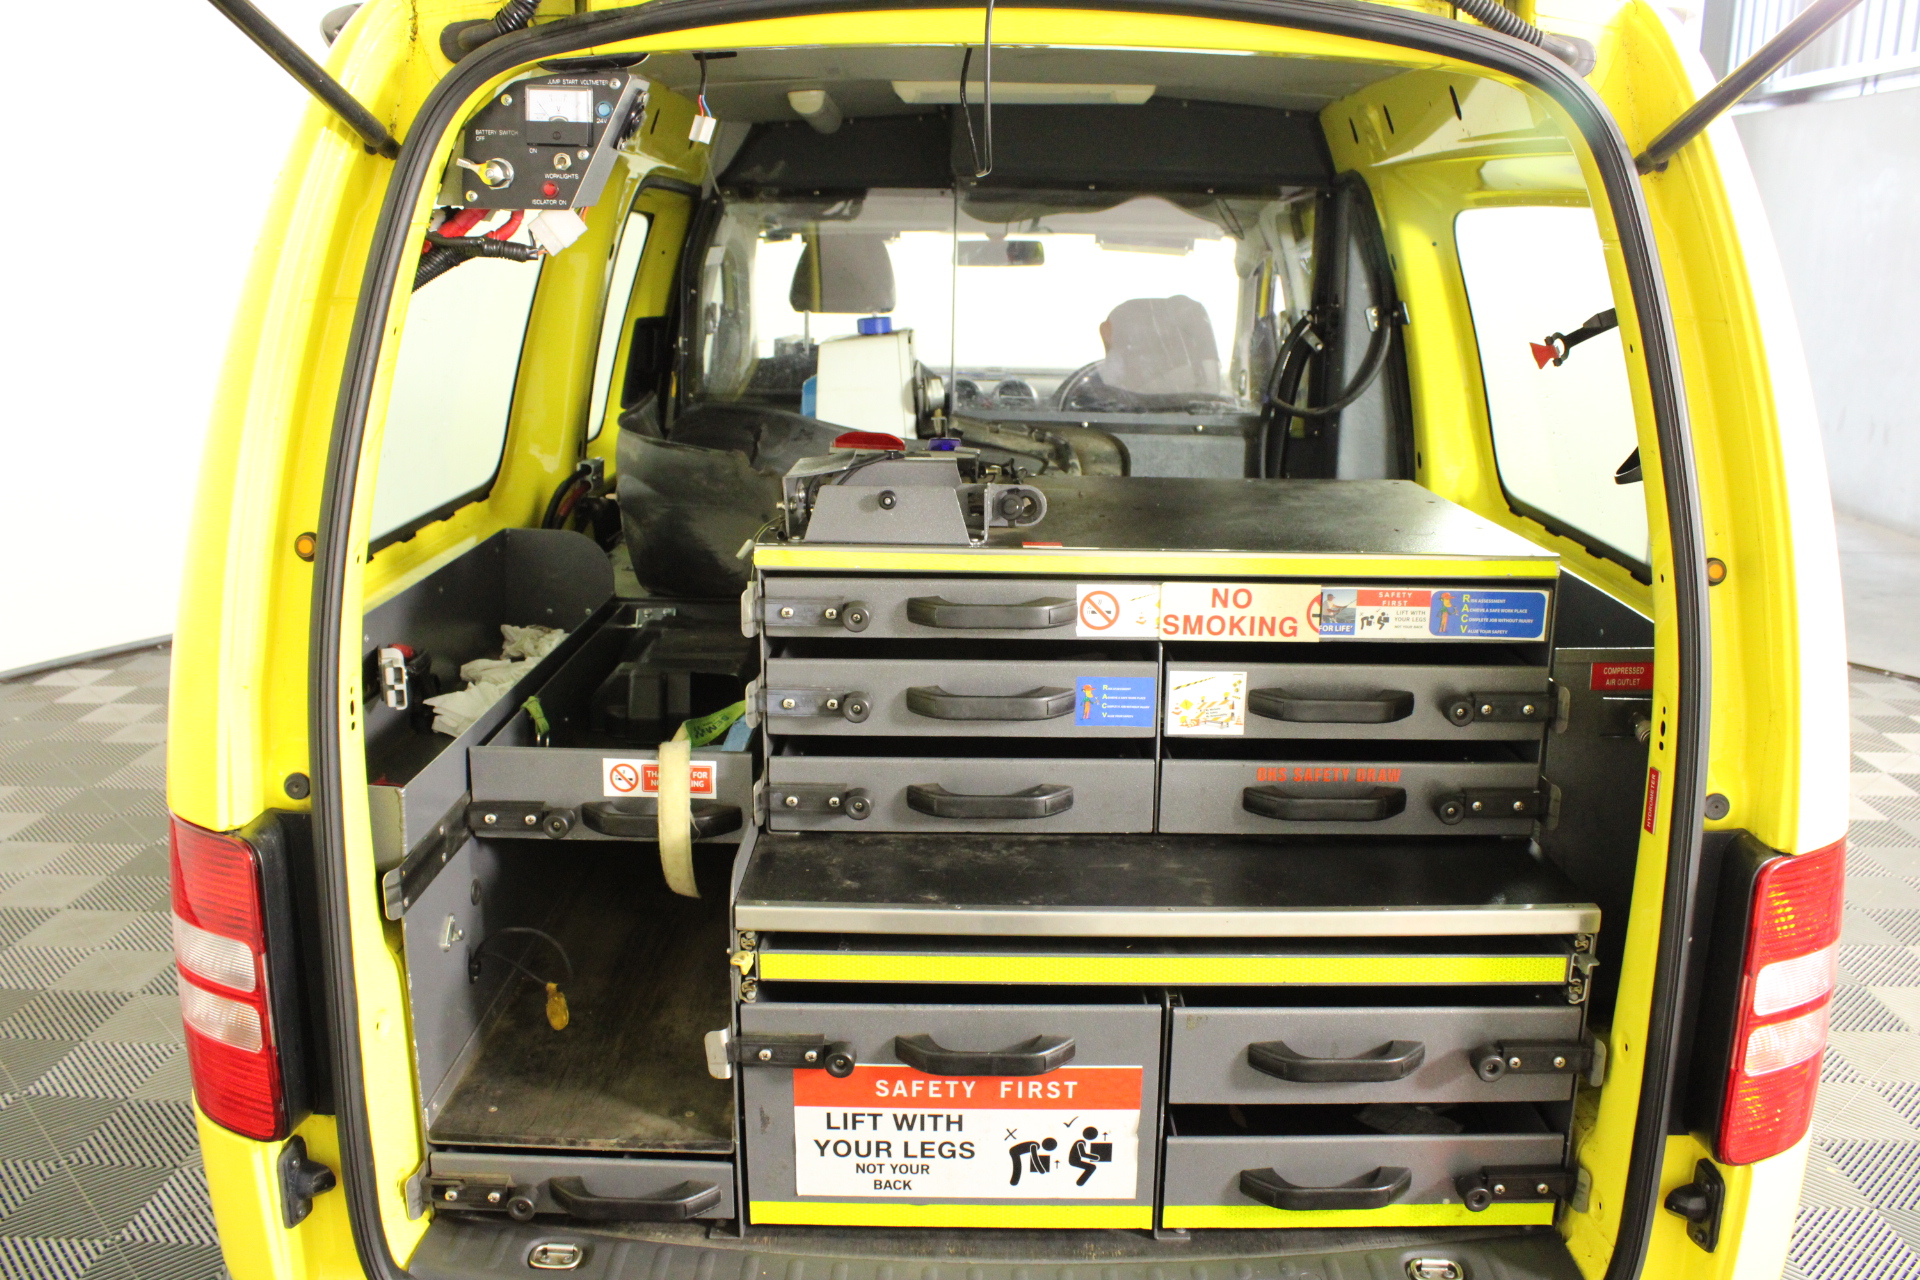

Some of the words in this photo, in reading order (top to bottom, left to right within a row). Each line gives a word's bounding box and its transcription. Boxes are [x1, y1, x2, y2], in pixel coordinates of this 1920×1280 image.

[1211, 588, 1253, 609] NO
[1162, 614, 1298, 638] SMOKING
[1603, 666, 1645, 675] COMPRESSED
[1617, 678, 1641, 686] OUTLET
[692, 771, 708, 779] FOR
[1292, 767, 1350, 782] SAFETY
[1355, 768, 1402, 783] DRAW
[1646, 774, 1656, 828] HYDROMETER
[875, 1079, 977, 1098] SAFETY
[1000, 1080, 1078, 1099] FIRST
[826, 1112, 883, 1131] LIFT
[892, 1113, 963, 1132] WITH
[813, 1139, 892, 1158] YOUR
[903, 1141, 976, 1160] LEGS
[855, 1163, 885, 1174] NOT
[890, 1163, 930, 1175] YOUR
[873, 1179, 913, 1191] BACK
